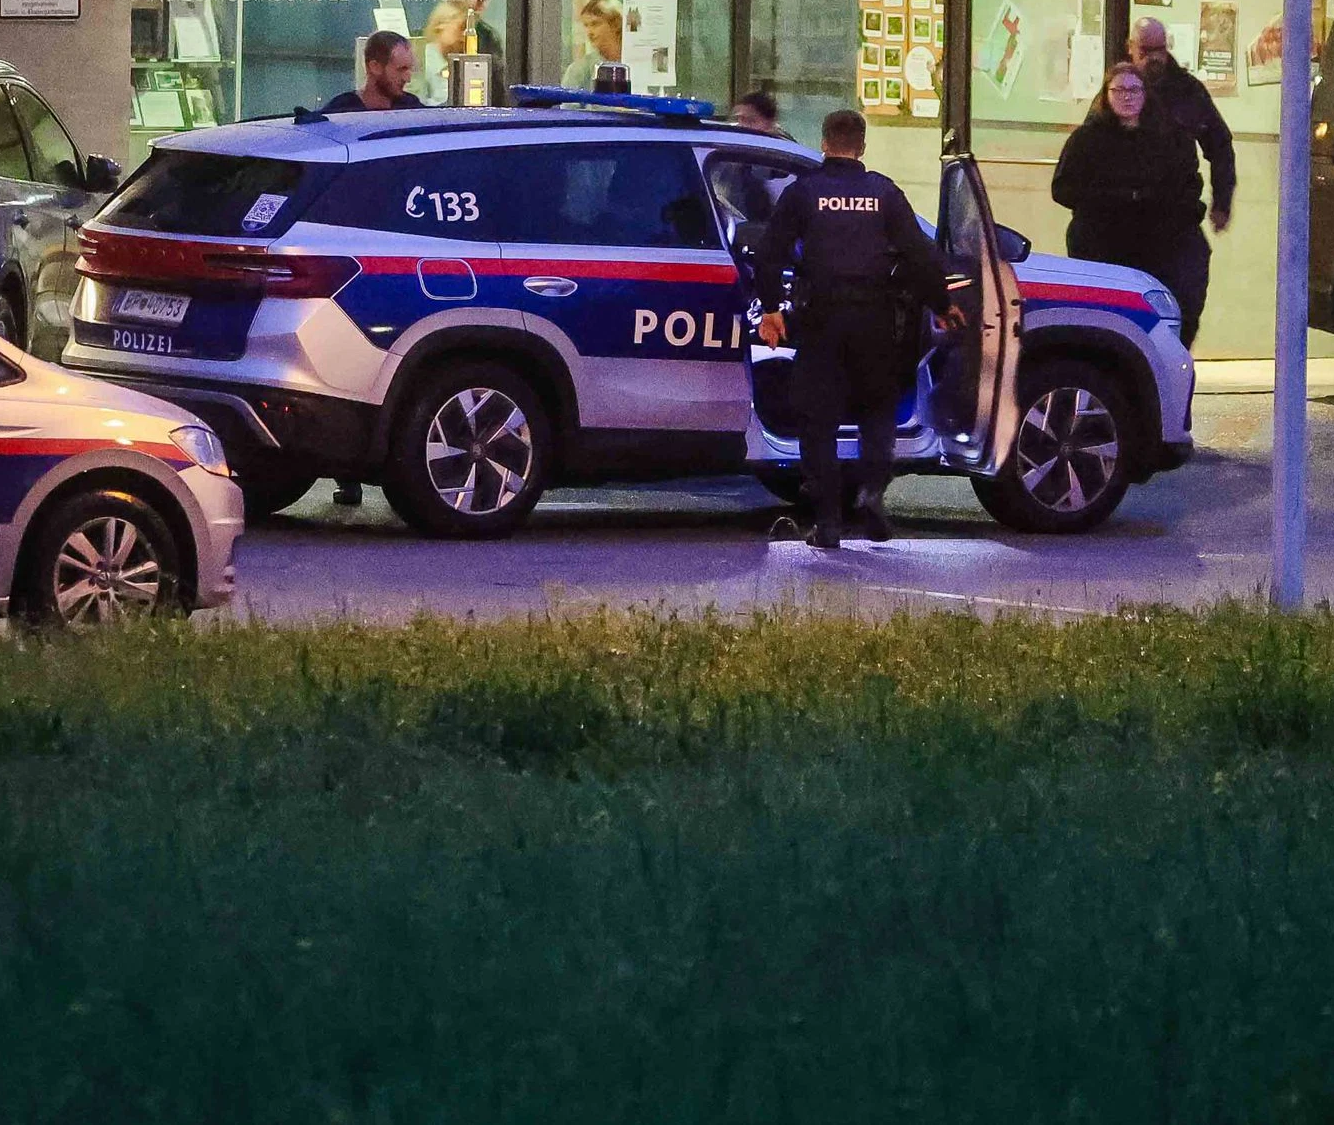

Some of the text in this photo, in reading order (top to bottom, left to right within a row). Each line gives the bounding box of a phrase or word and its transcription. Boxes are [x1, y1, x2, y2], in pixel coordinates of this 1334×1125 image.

[428, 192, 480, 222] 133
[818, 197, 879, 212] POLIZEI
[113, 330, 172, 353] POLIZEI
